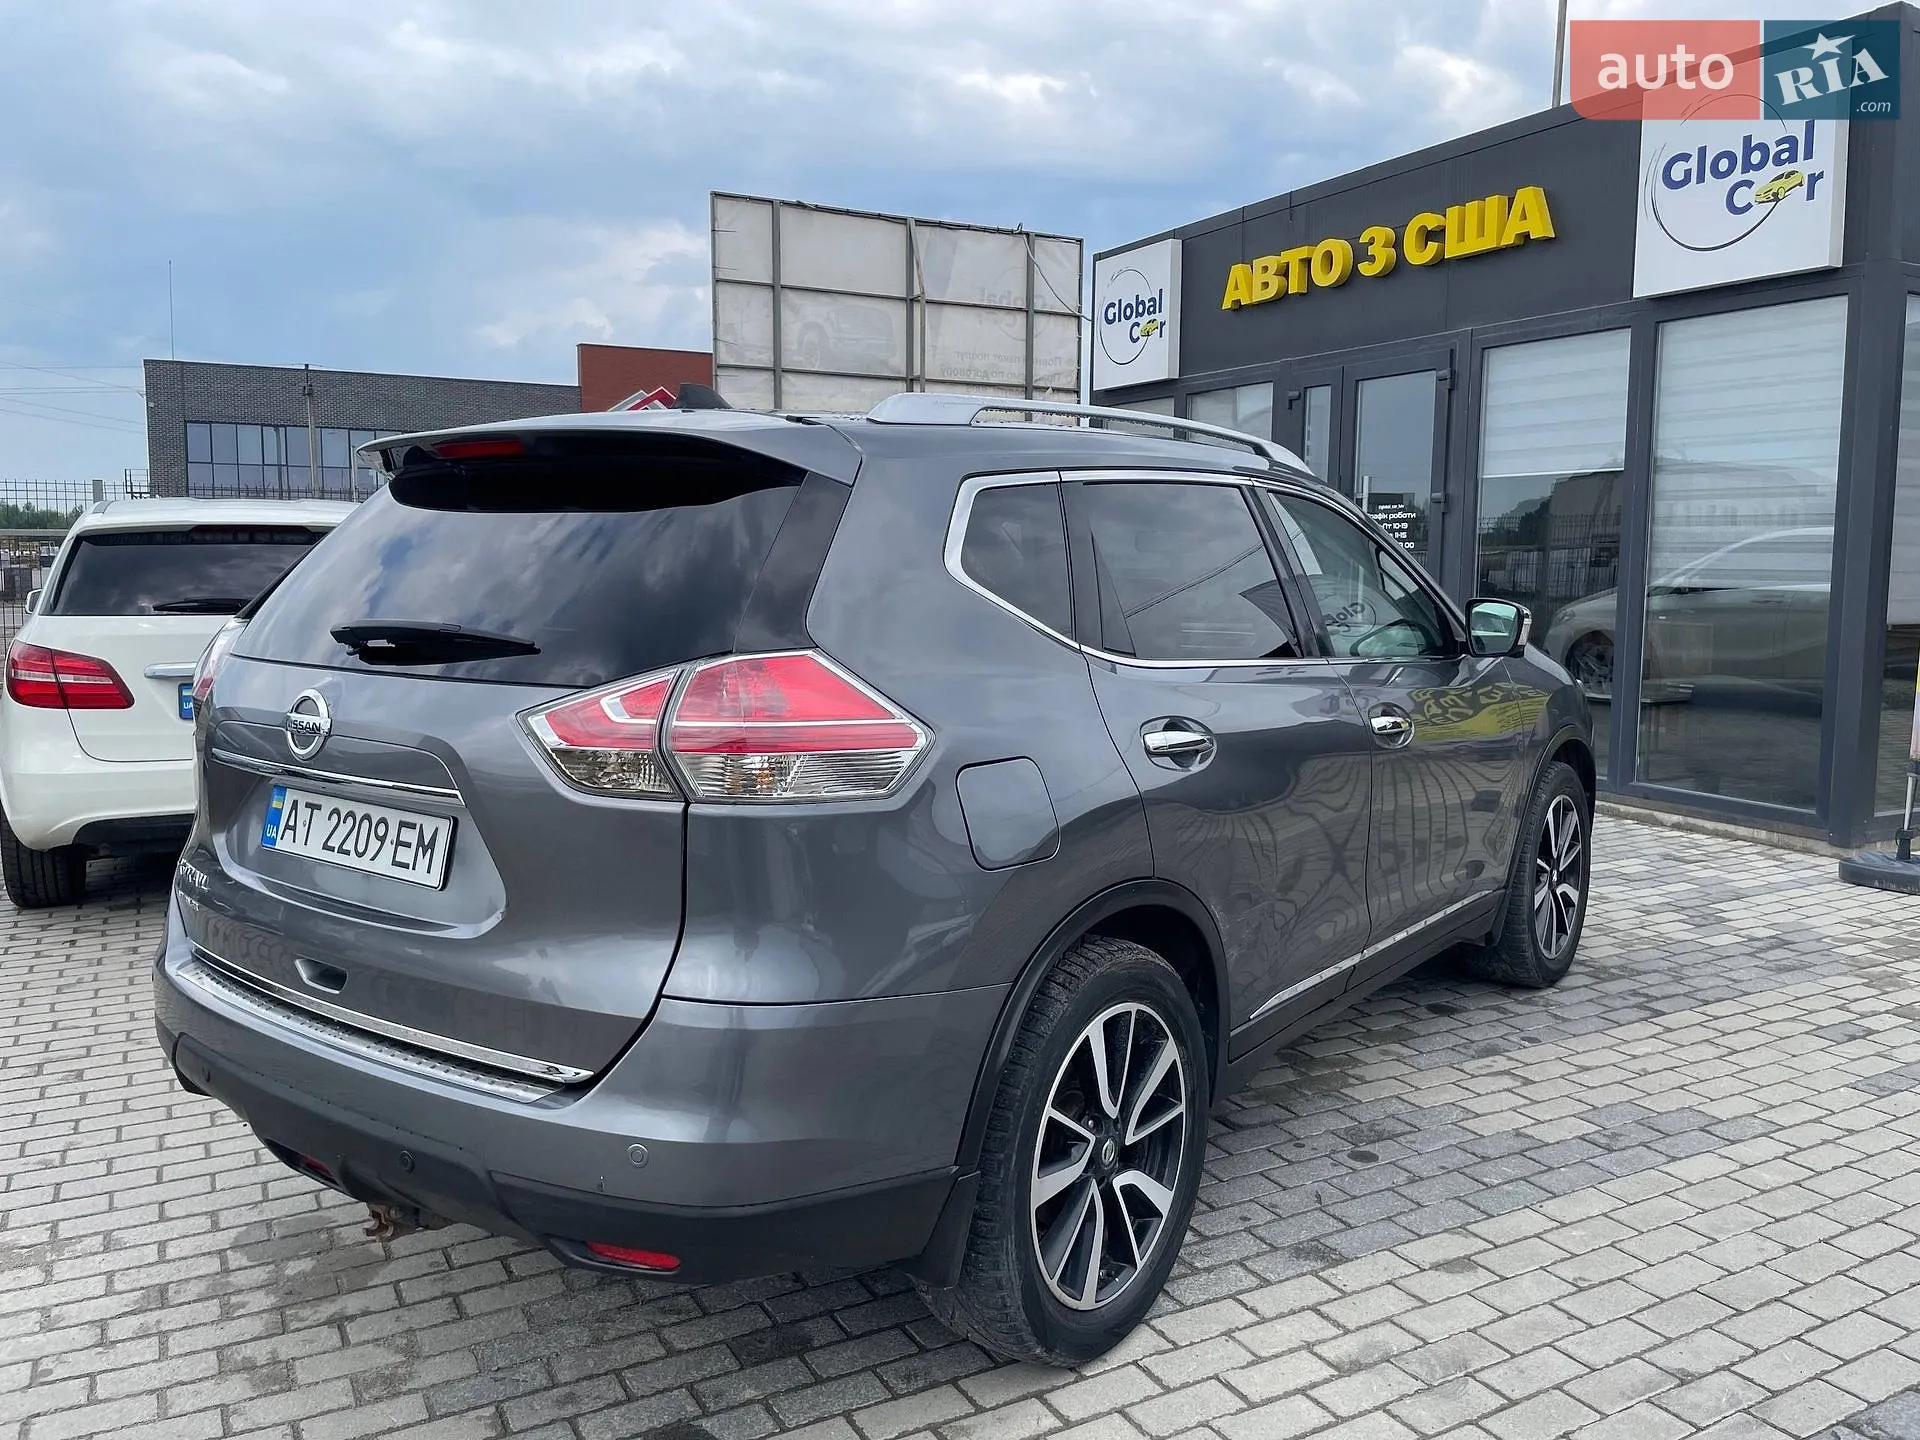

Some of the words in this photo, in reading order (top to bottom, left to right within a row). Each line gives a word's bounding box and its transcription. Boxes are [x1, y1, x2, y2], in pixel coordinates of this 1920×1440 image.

[1661, 118, 1816, 191] Global
[1724, 168, 1825, 216] Cr
[1221, 238, 1354, 310] АВТО
[1403, 185, 1556, 267] США
[1103, 288, 1164, 325] Global
[1129, 319, 1167, 344] Cr
[1389, 511, 1416, 521] роботи
[266, 823, 278, 839] UA
[280, 799, 323, 847] AT
[321, 806, 390, 862] 2209
[390, 818, 439, 875] EM
